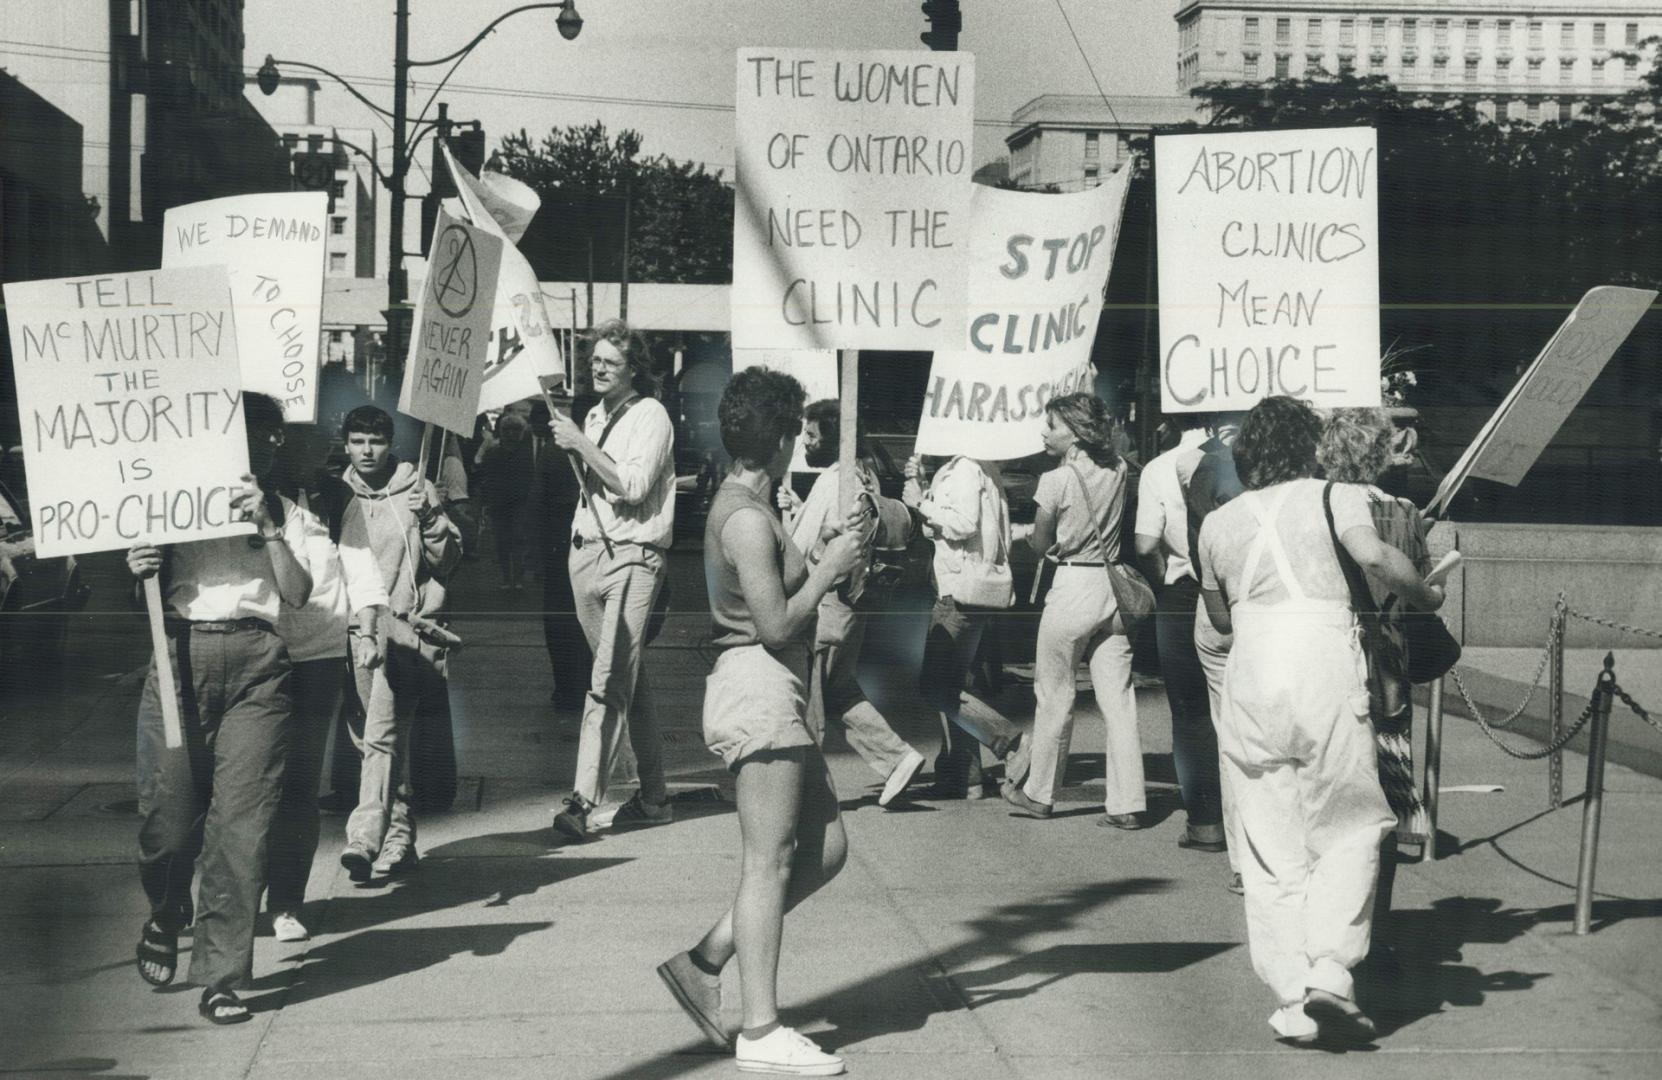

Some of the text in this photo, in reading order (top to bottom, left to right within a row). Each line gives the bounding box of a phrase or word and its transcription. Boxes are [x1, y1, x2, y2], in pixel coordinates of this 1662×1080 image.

[747, 57, 960, 107] THE WOMEN
[767, 132, 964, 176] OF ONTARIO
[1177, 146, 1373, 199] ABORTION
[177, 214, 321, 252] WE DEMAND
[769, 207, 953, 249] NEED THE
[1222, 221, 1366, 263] CLINICS
[1000, 224, 1106, 281] STOP
[66, 275, 173, 309] TELL
[782, 278, 941, 328] CLINIC
[1218, 280, 1323, 327] MEAN
[252, 274, 306, 408] TO CHOOSE
[969, 294, 1090, 354] CLINIC
[94, 369, 161, 392] THE
[417, 357, 469, 399] AGAIN
[1165, 334, 1347, 406] CHOICE
[34, 388, 243, 452] MAJORITY
[118, 458, 153, 483] IS
